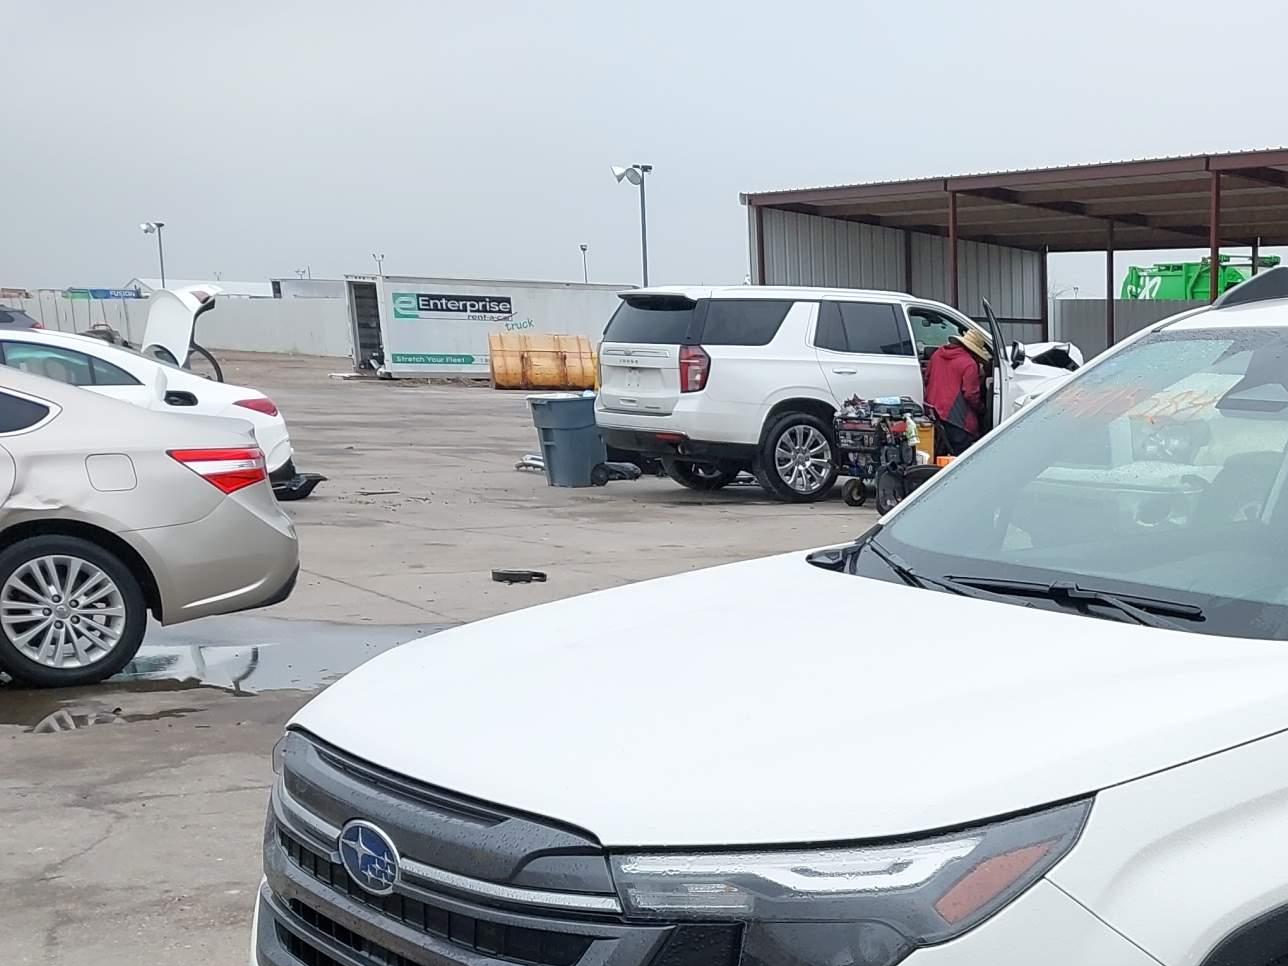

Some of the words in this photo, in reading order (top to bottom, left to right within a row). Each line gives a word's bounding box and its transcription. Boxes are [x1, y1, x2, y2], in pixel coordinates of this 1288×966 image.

[109, 290, 136, 298] FUSION
[418, 296, 511, 314] Enterprise
[505, 318, 534, 331] truck
[396, 355, 426, 363] Stretch
[427, 355, 445, 363] Your
